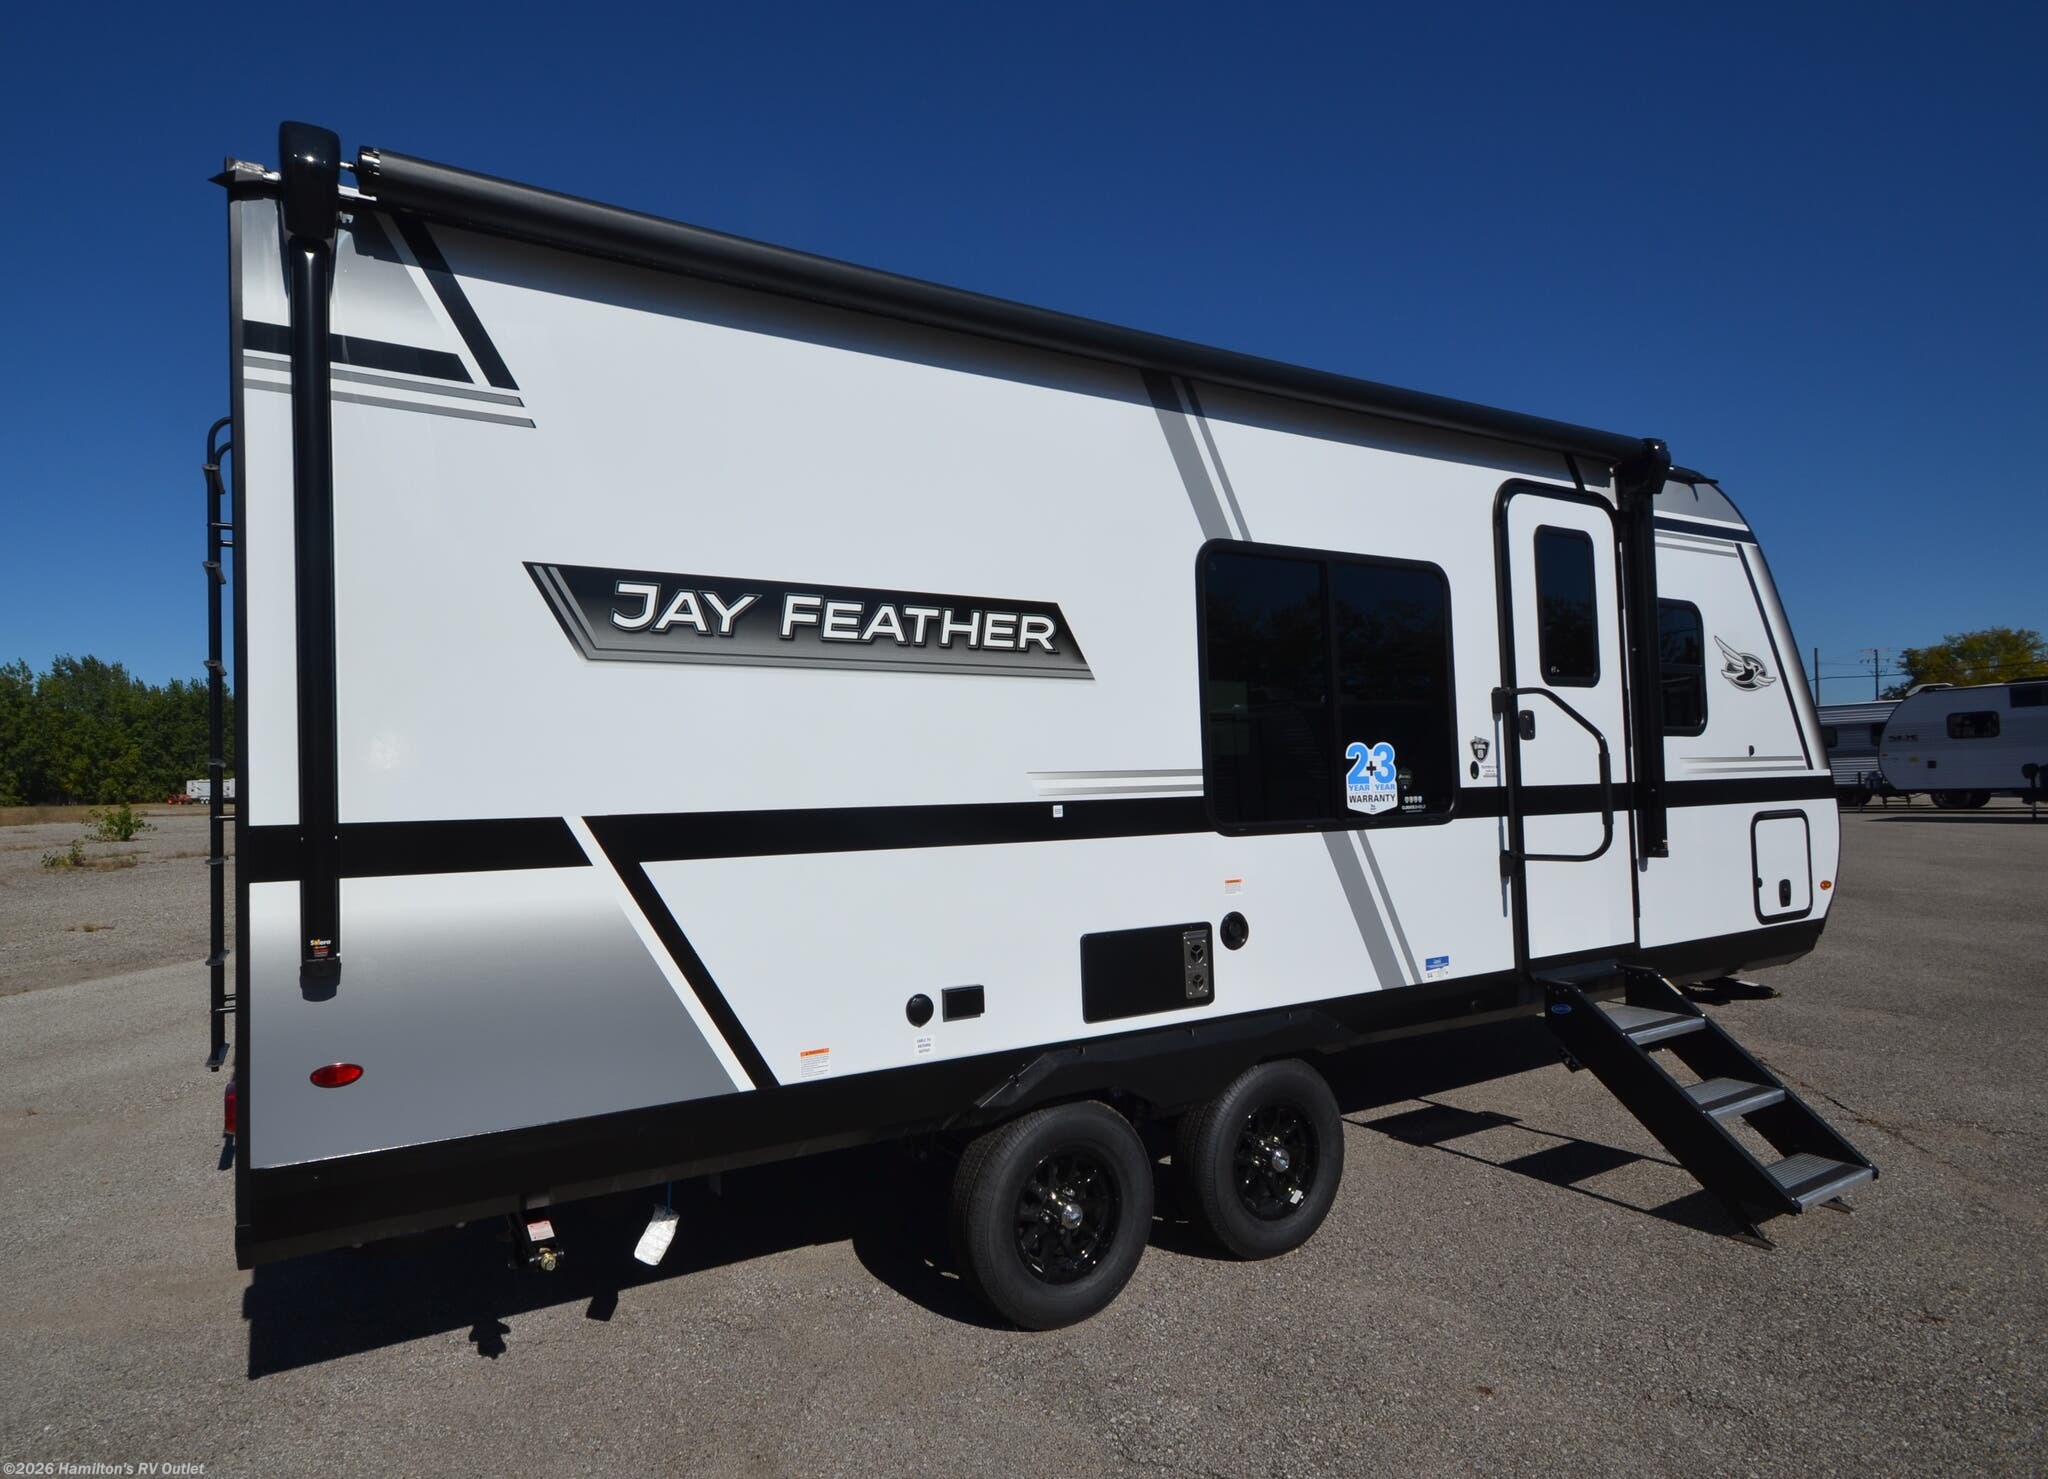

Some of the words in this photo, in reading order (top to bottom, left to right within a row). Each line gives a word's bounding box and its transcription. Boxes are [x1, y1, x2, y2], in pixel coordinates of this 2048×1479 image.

[610, 580, 762, 636] JAY
[779, 593, 1060, 653] FEATHER
[1348, 784, 1370, 792] YEAR
[1375, 783, 1396, 791] YEAR
[1349, 794, 1396, 804] WARRANTY
